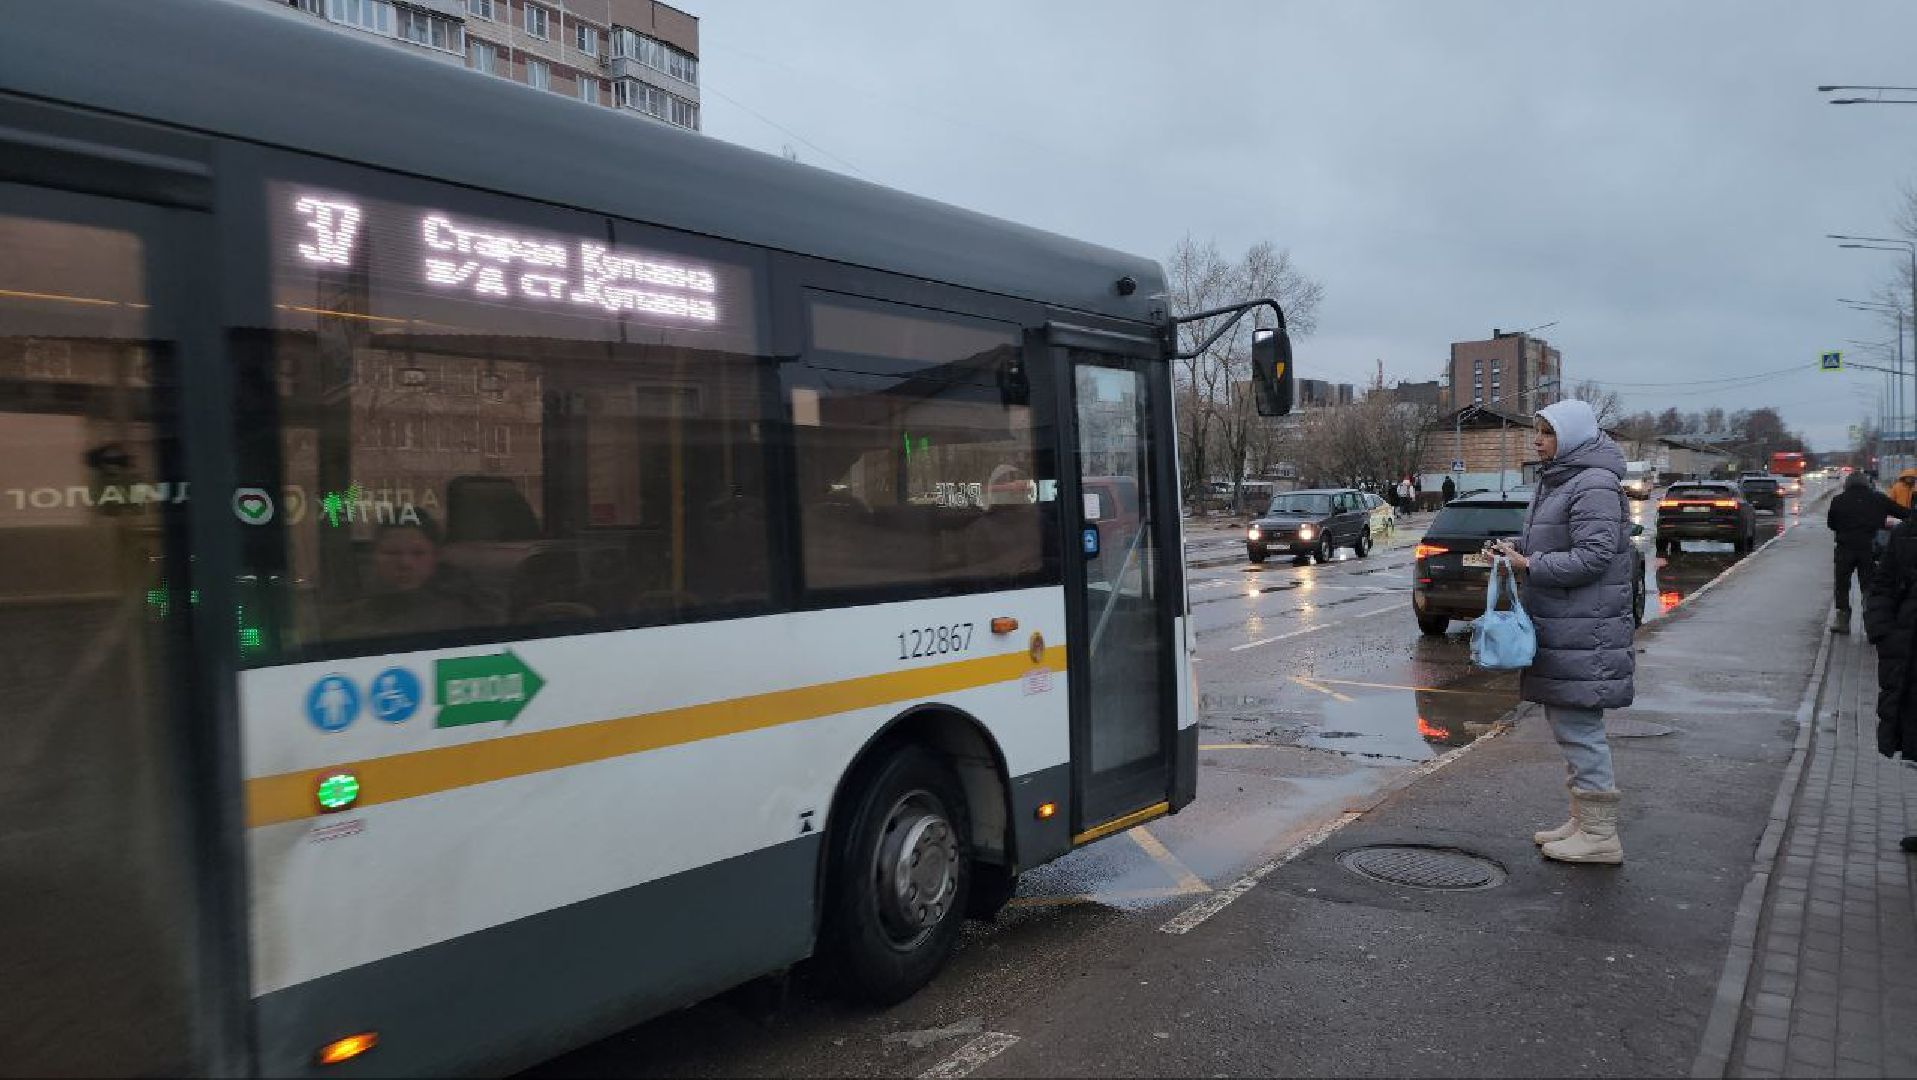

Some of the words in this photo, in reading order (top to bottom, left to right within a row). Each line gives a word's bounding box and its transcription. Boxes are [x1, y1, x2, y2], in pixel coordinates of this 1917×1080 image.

[297, 197, 361, 266] 37
[422, 215, 568, 269] Старая
[581, 241, 717, 293] Купавна
[897, 622, 974, 660] 122867
